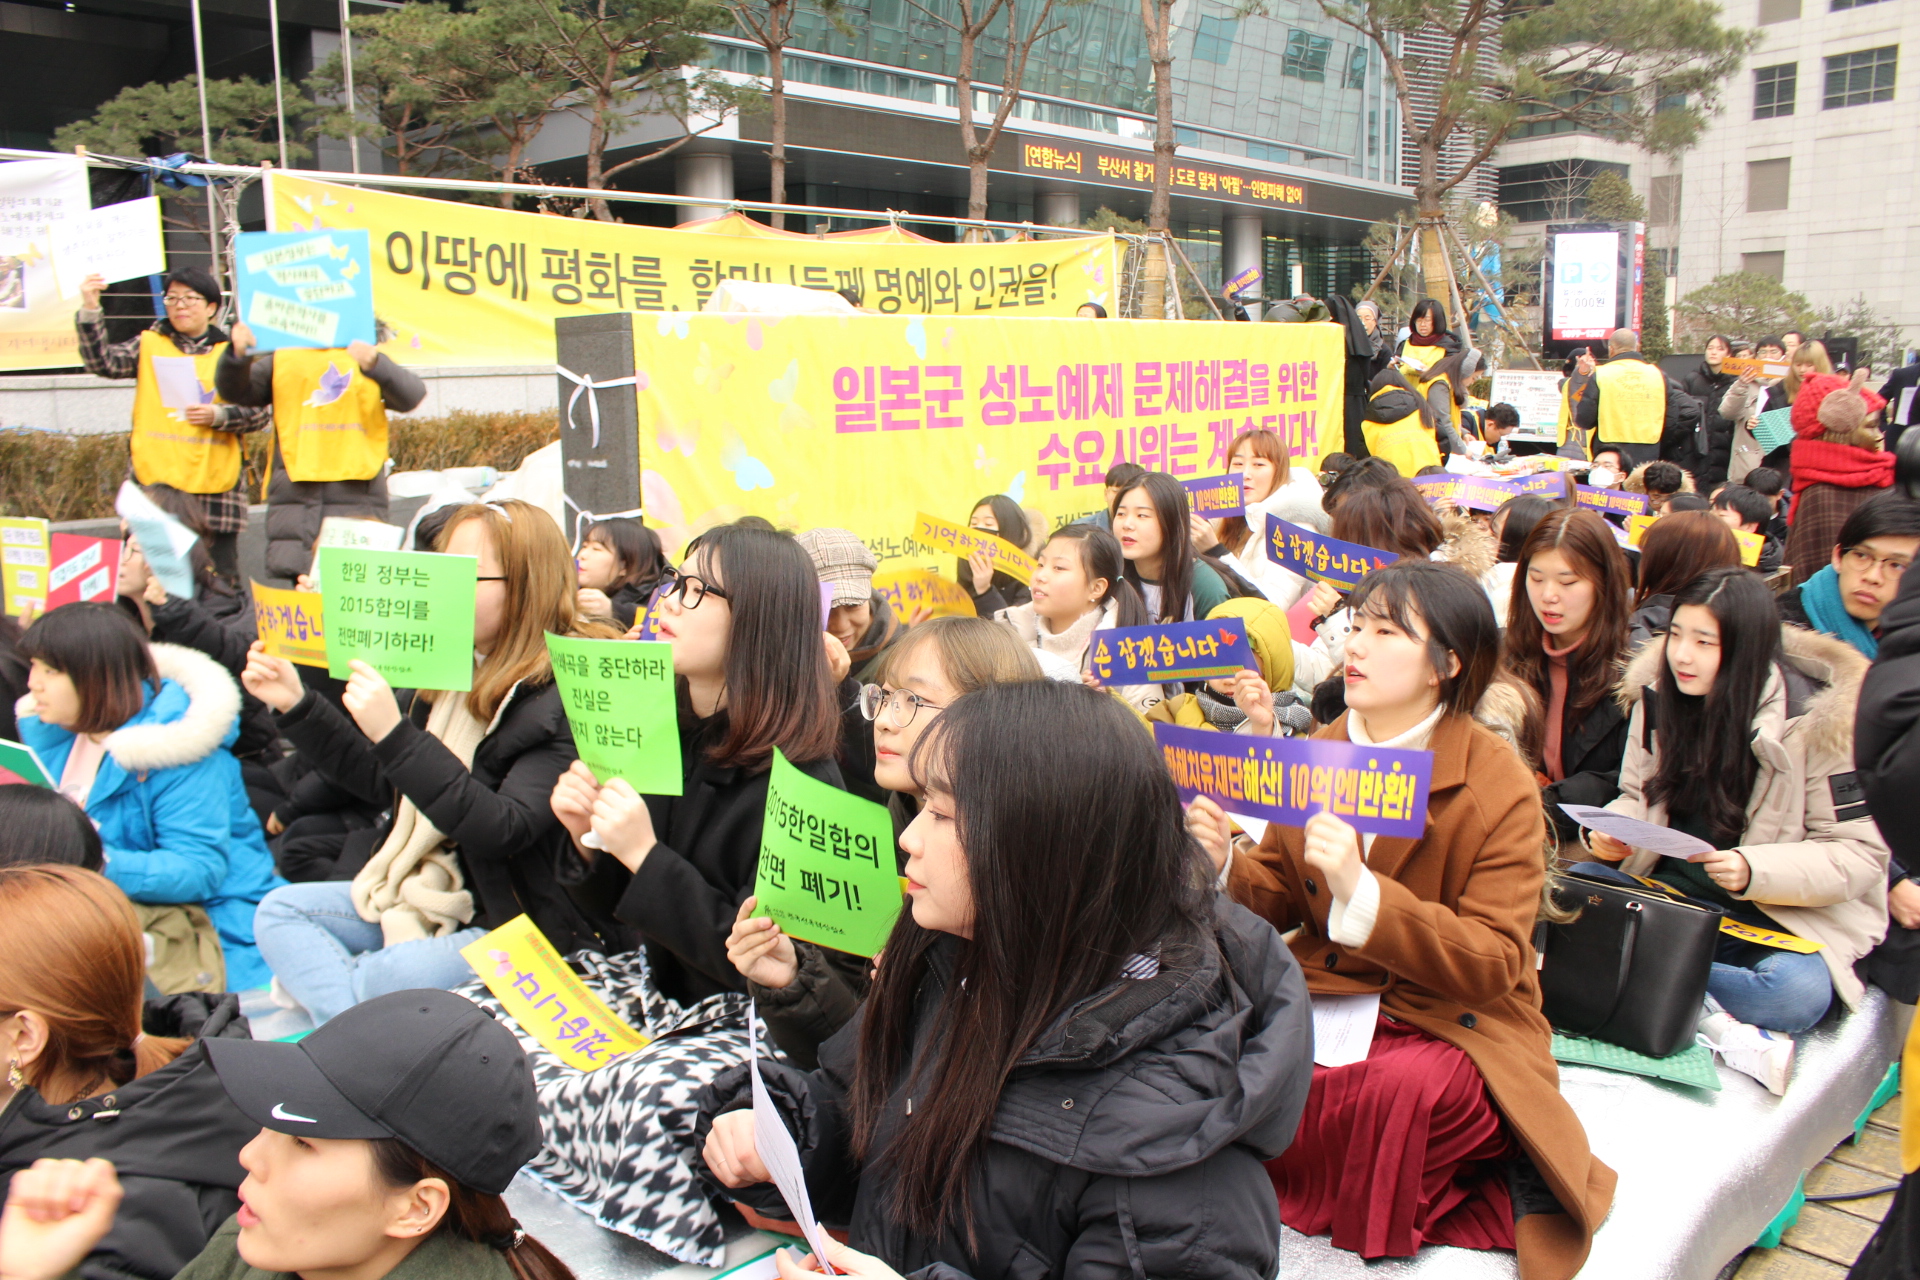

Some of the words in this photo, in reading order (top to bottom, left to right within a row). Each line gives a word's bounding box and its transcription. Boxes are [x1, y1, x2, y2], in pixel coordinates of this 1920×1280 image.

[1025, 144, 1082, 174] [연합뉴스]
[1096, 155, 1131, 180] 부산서
[1176, 168, 1197, 187] 도로
[1198, 171, 1217, 192] 덮쳐
[1286, 186, 1303, 205] 없어
[385, 230, 528, 302] 이땅에
[875, 267, 963, 315] 명예와
[970, 262, 1060, 311] 인권을!
[833, 366, 964, 434] 일본군
[979, 363, 1124, 427] 성노예제
[1133, 358, 1270, 418] 문제해결을
[1277, 361, 1319, 404] 위한
[1196, 481, 1241, 512] 10억엔반환!
[1271, 524, 1286, 560] 손
[1289, 533, 1372, 576] 잡겠습니다
[341, 561, 368, 583] 한일
[376, 564, 431, 588] 정부는
[339, 595, 431, 621] 2015합의를
[337, 626, 435, 653] 전면폐기하라!
[1093, 635, 1112, 679] 손
[1119, 633, 1220, 669] 잡겠습니다
[598, 657, 666, 681] 중단하라
[571, 687, 612, 713] 진실은
[594, 724, 643, 749] 않는다
[1289, 758, 1417, 821] 10억엔반환!
[766, 784, 880, 870] 2015한일합의
[759, 844, 786, 891] 전면
[799, 869, 863, 912] 폐기!
